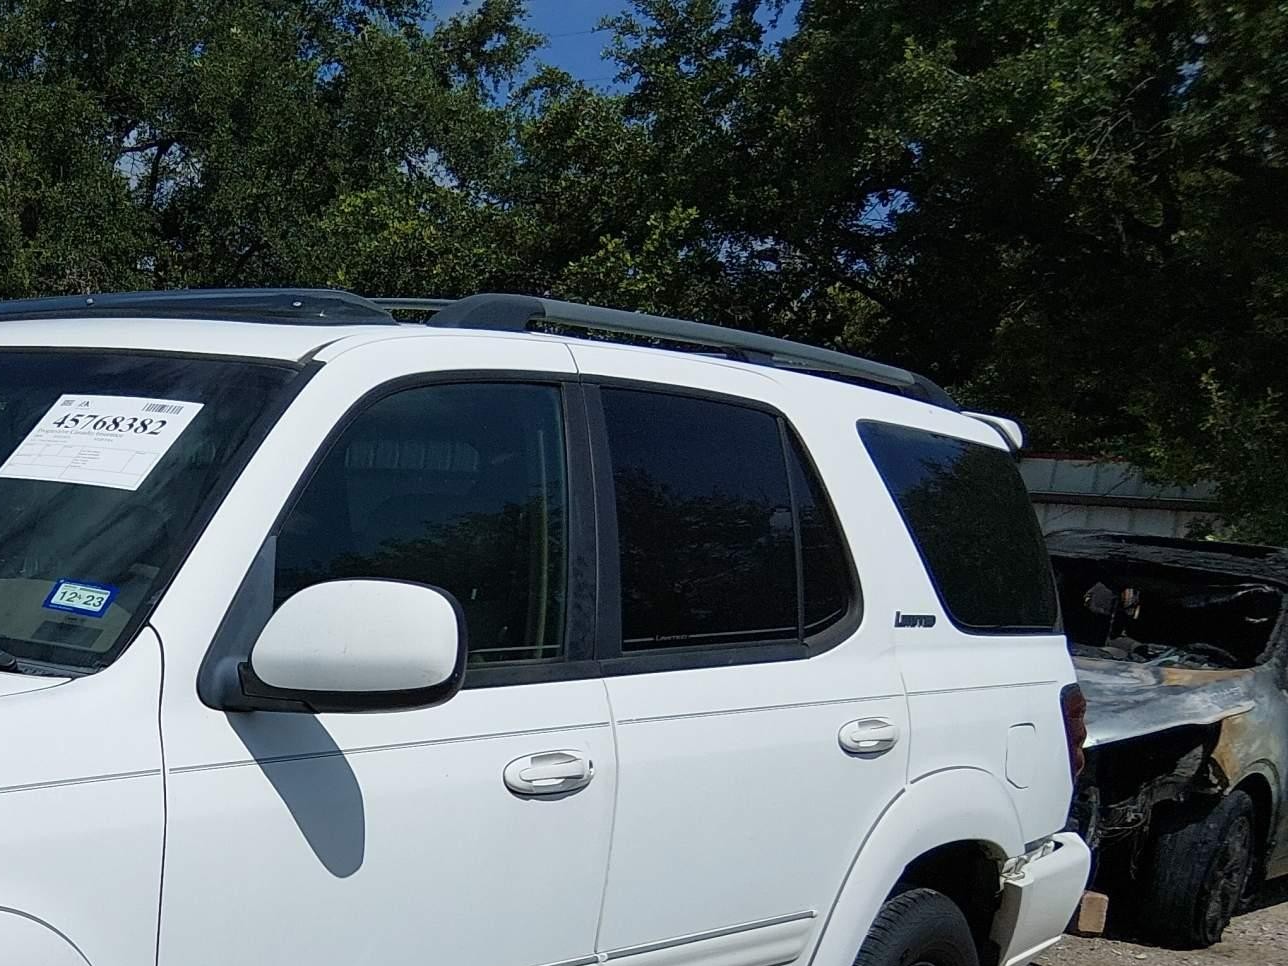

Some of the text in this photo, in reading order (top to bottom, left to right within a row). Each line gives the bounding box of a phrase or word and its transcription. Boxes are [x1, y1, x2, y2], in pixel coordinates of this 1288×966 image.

[52, 412, 168, 436] 45768382
[59, 590, 79, 603] 12
[82, 594, 105, 608] 23
